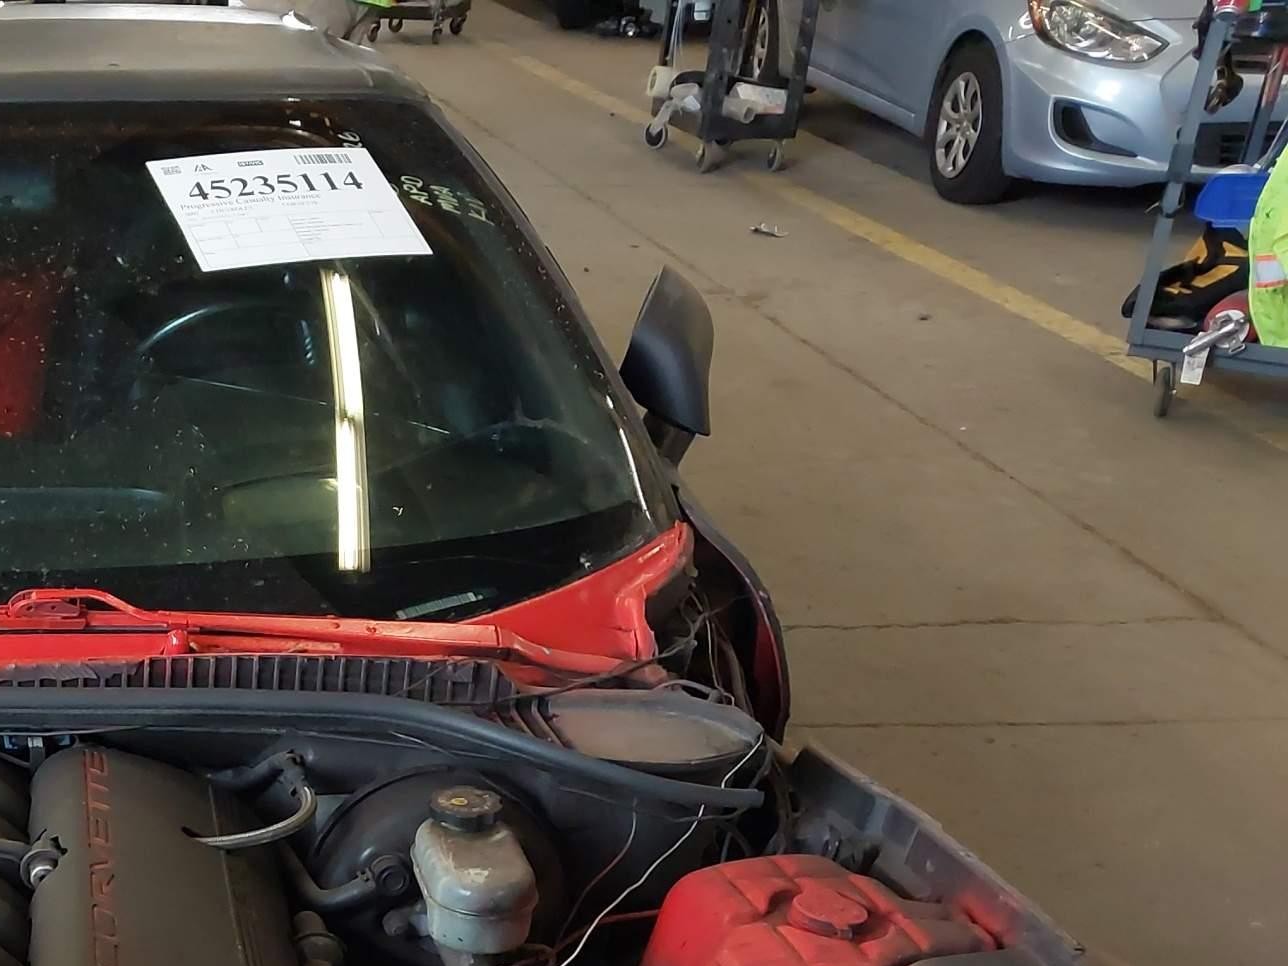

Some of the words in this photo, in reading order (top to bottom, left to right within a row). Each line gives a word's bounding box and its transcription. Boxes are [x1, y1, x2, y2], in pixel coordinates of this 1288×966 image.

[189, 171, 364, 201] 45235114
[179, 199, 234, 211] Progressive
[235, 194, 275, 205] Casualty
[277, 193, 321, 202] Insurance
